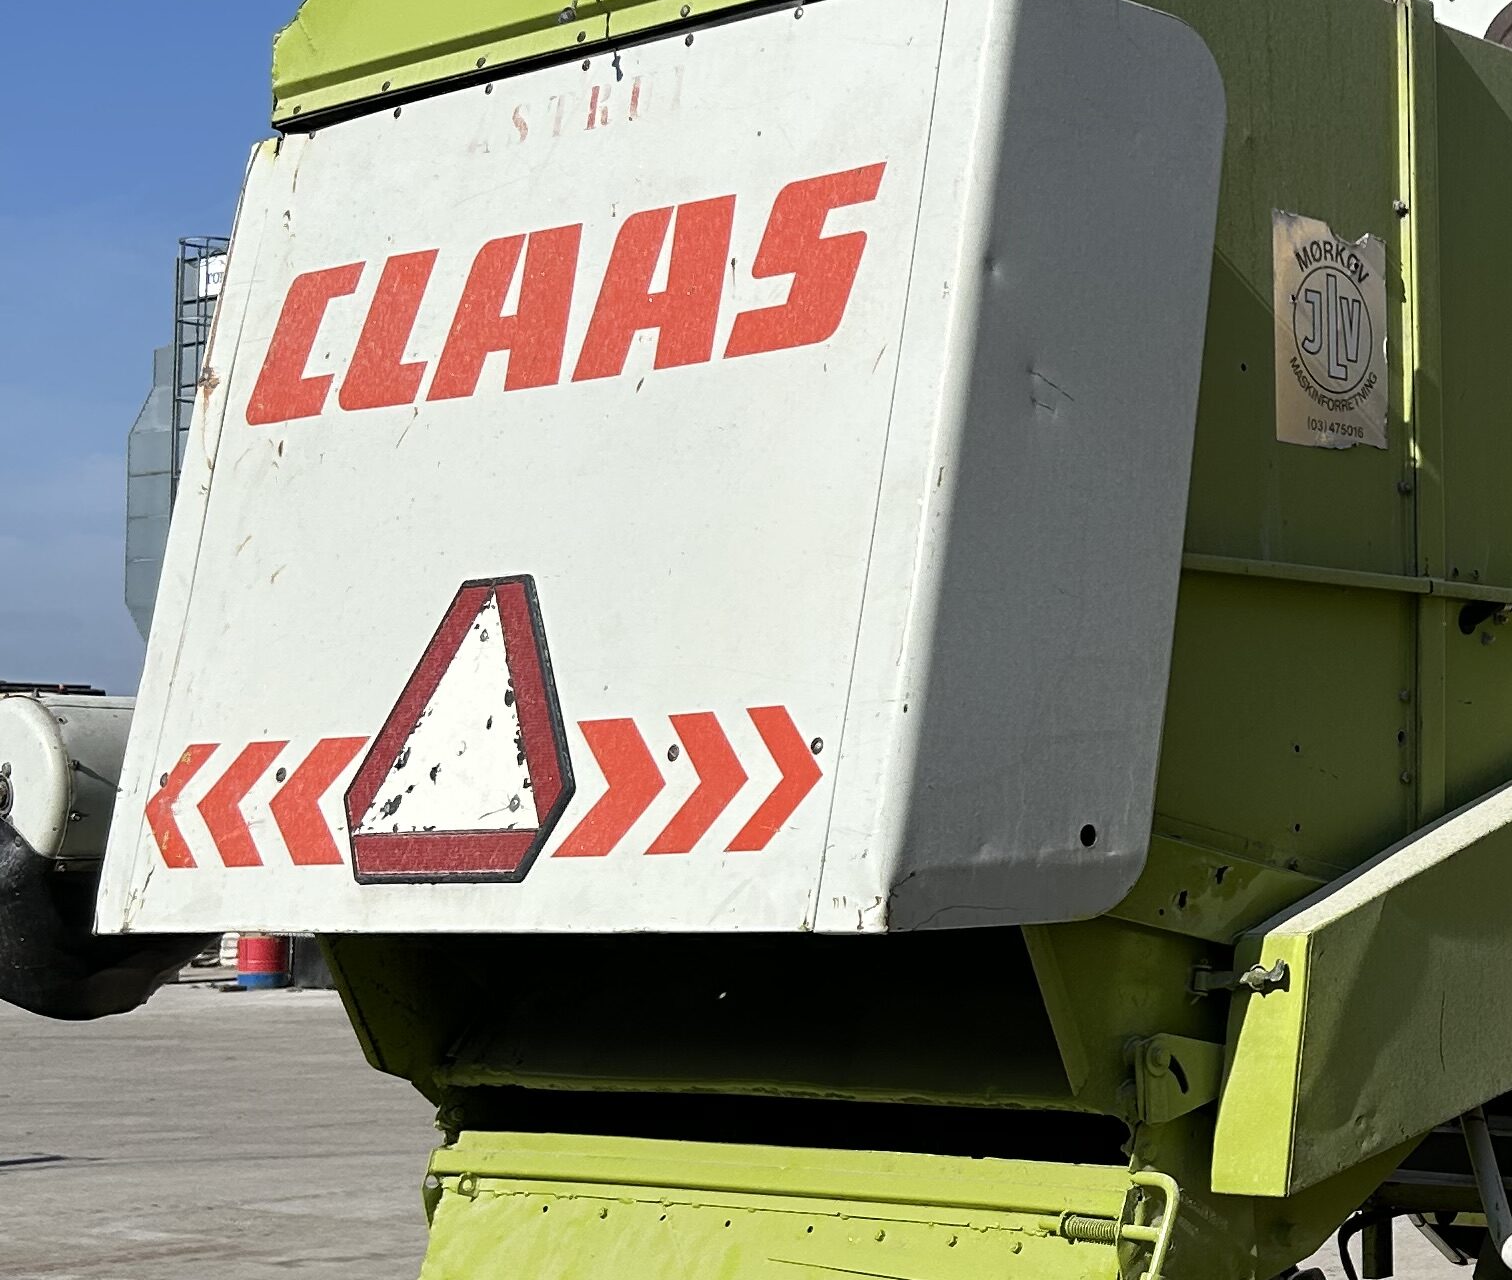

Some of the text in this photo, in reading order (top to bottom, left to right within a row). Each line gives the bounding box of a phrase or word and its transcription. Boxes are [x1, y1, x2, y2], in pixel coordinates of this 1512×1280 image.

[1294, 240, 1369, 284] MØRKØV
[245, 162, 887, 426] CLAAS
[1289, 356, 1377, 412] MASKINFORRETNING
